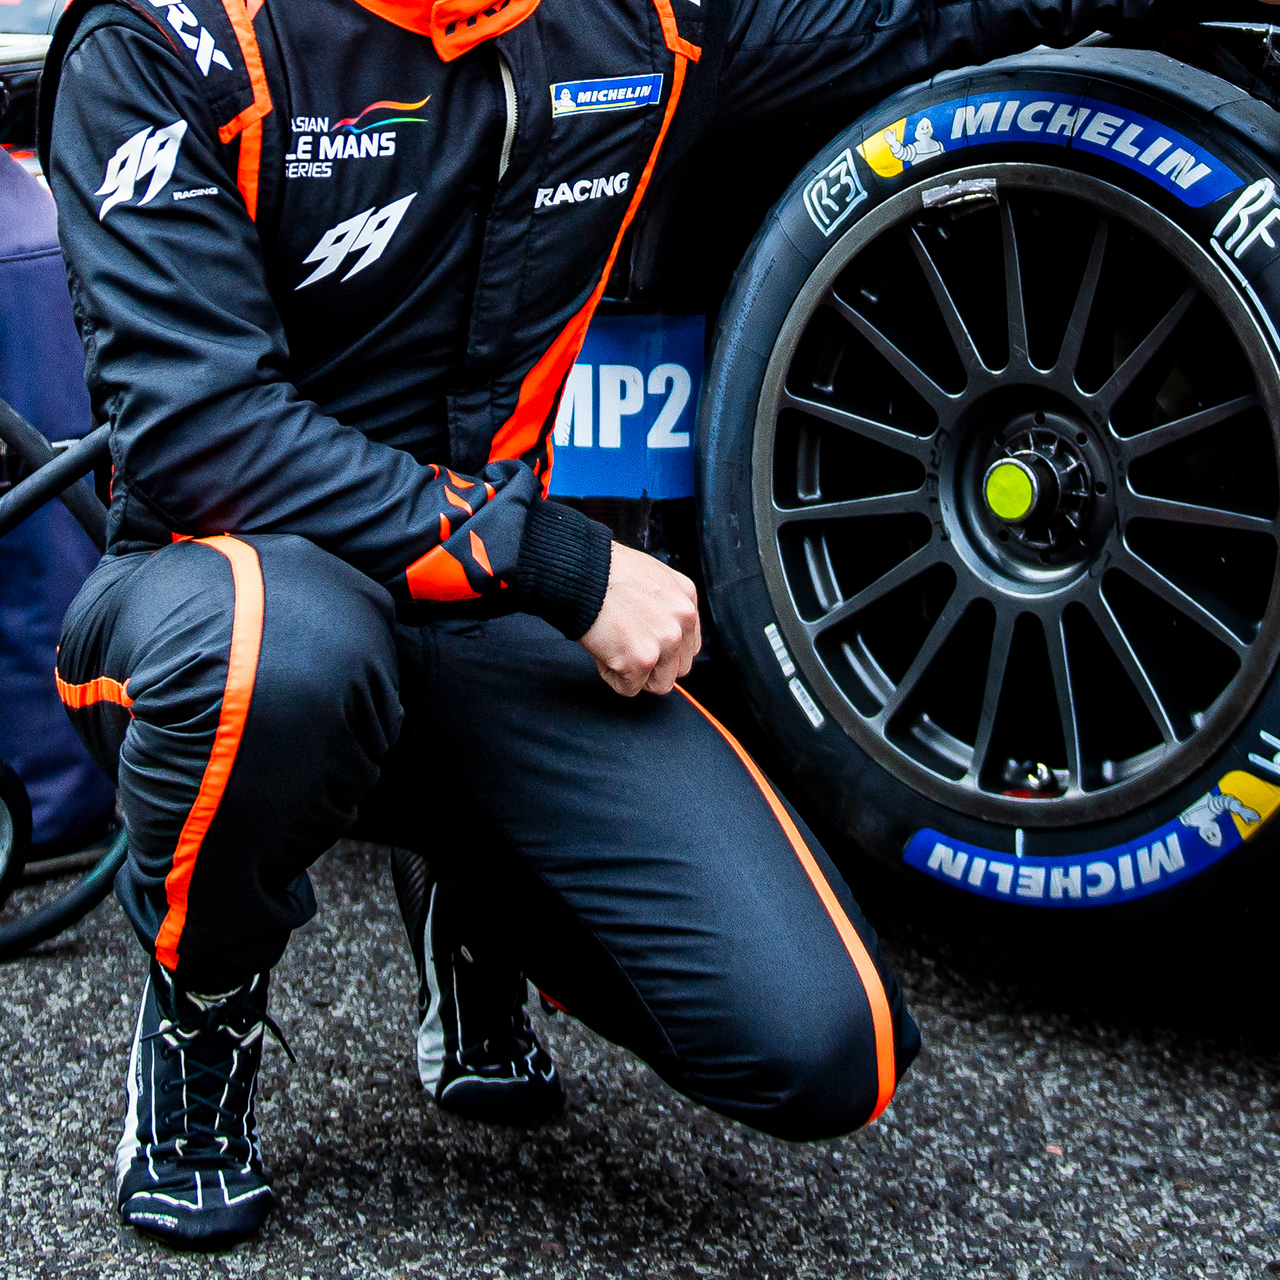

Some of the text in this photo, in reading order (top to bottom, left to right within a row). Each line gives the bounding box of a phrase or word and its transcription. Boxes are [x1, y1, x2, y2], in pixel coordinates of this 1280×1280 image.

[576, 84, 653, 104] MICHELIN
[93, 119, 219, 221] 99 RACING
[318, 131, 397, 160] MANS
[950, 98, 1214, 191] MICHELIN
[533, 171, 631, 209] RACING
[293, 191, 419, 292] 99
[927, 832, 1186, 901] MICHELIN
